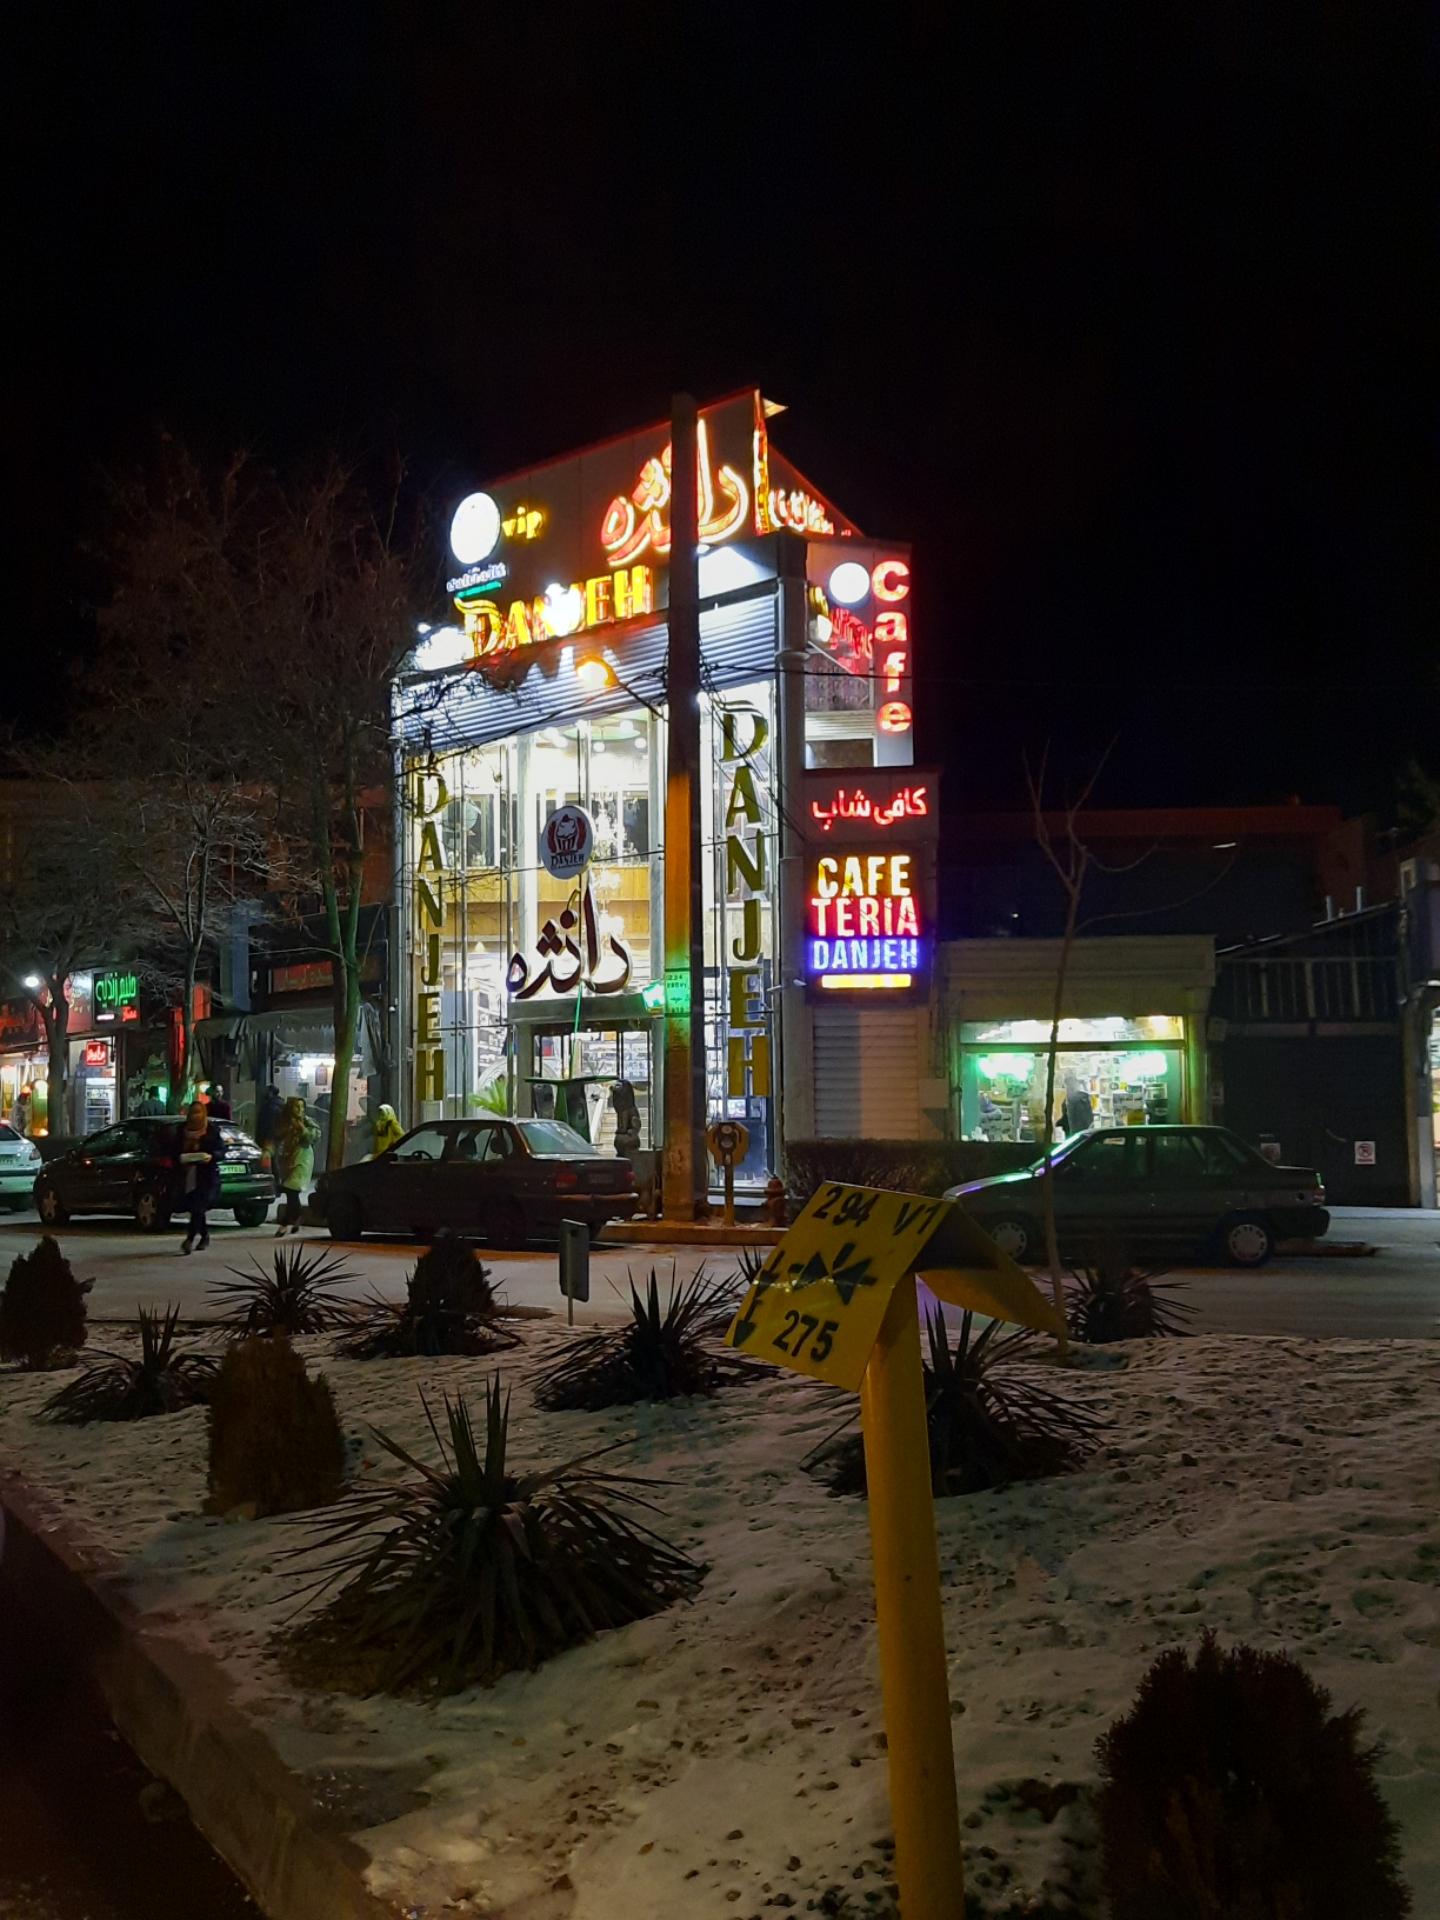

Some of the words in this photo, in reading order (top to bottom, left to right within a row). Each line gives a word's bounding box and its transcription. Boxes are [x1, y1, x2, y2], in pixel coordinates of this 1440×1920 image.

[719, 699, 769, 1097] DANJEH
[817, 856, 911, 898] CAFE
[416, 765, 447, 1100] DANJEH
[506, 884, 630, 1000] دانژه
[813, 939, 918, 970] DANJEH
[812, 1186, 879, 1227] 294
[893, 1201, 943, 1236] V1
[772, 1310, 839, 1362] 275
